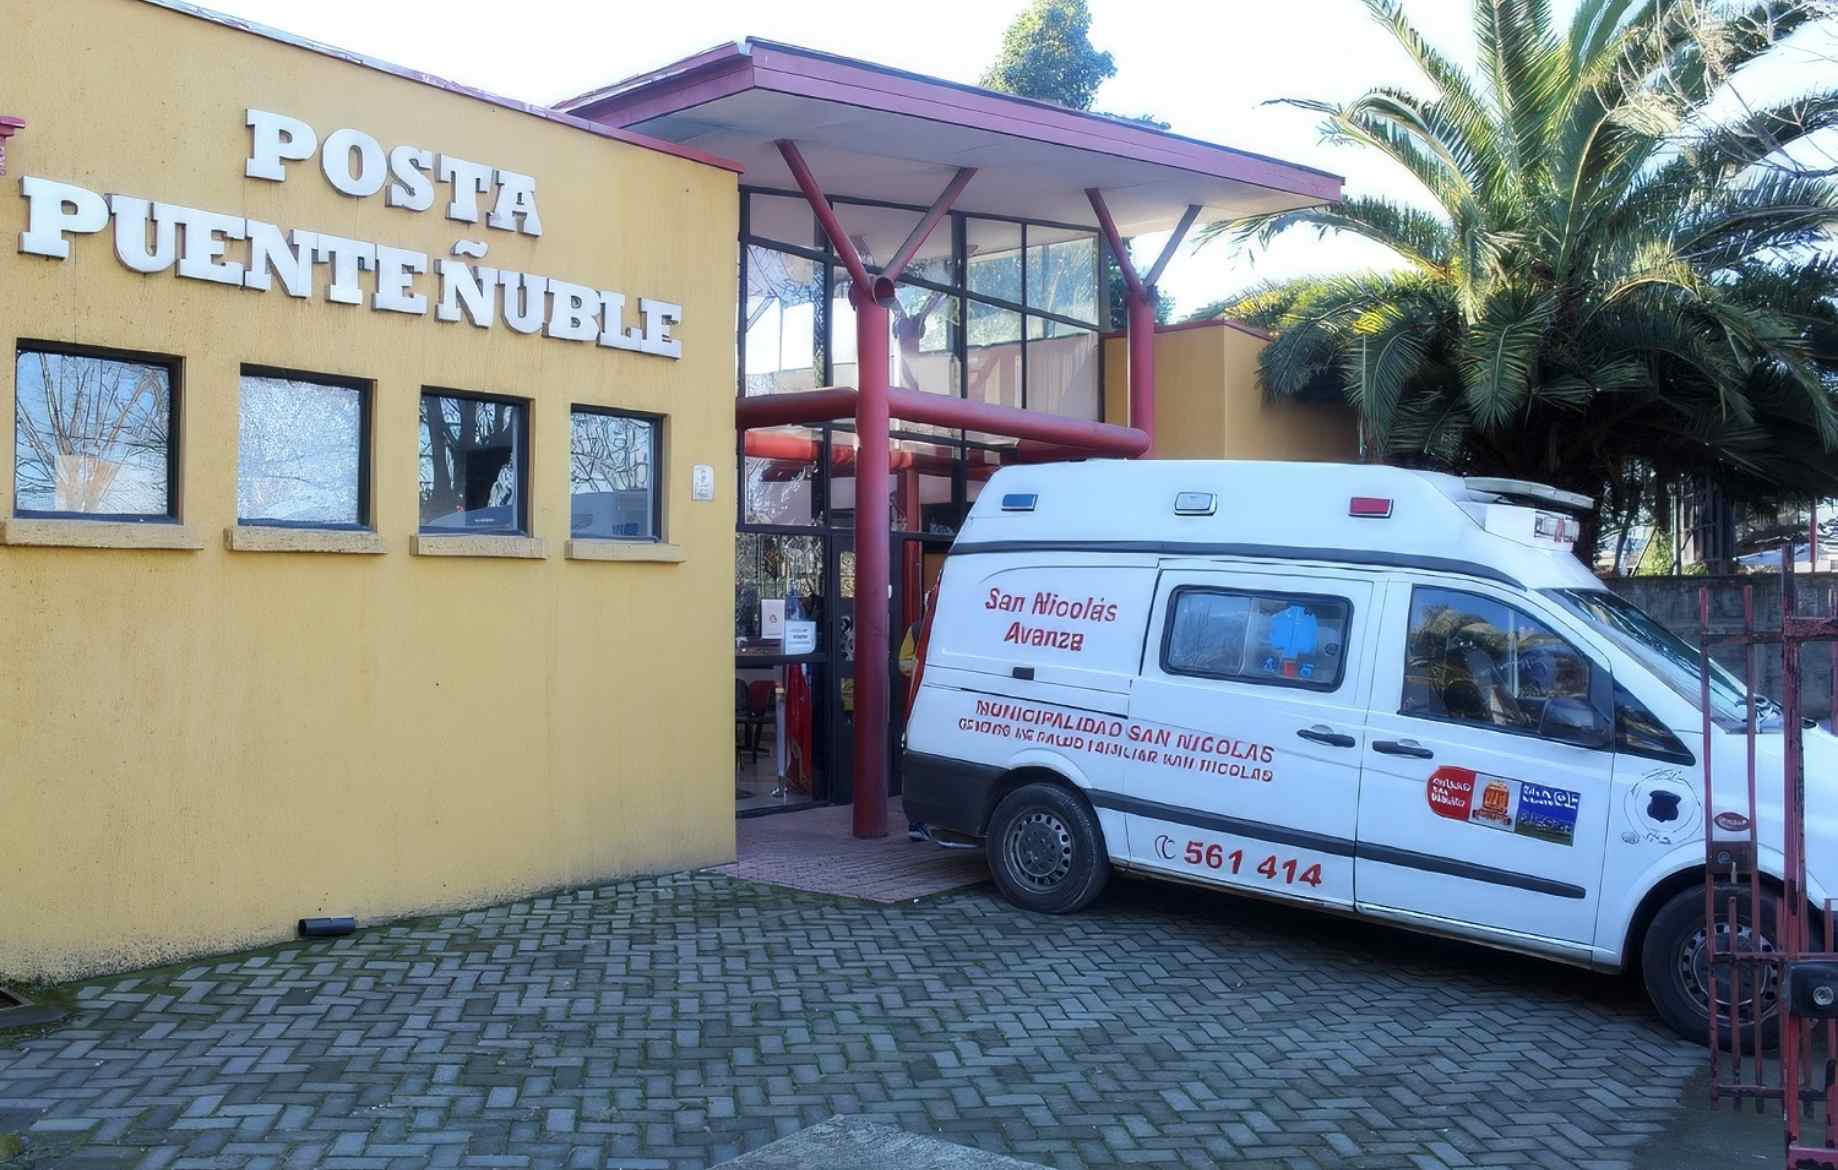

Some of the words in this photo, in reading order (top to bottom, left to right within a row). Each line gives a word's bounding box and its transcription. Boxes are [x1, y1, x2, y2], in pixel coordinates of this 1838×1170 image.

[245, 108, 541, 236] POSTA
[985, 587, 1025, 612] San
[976, 700, 1122, 737] MUNICIPALIDAD
[1128, 724, 1171, 747] SAN
[1177, 733, 1275, 763] NICOLAS
[1184, 840, 1243, 875] 561
[1257, 855, 1322, 887] 414
